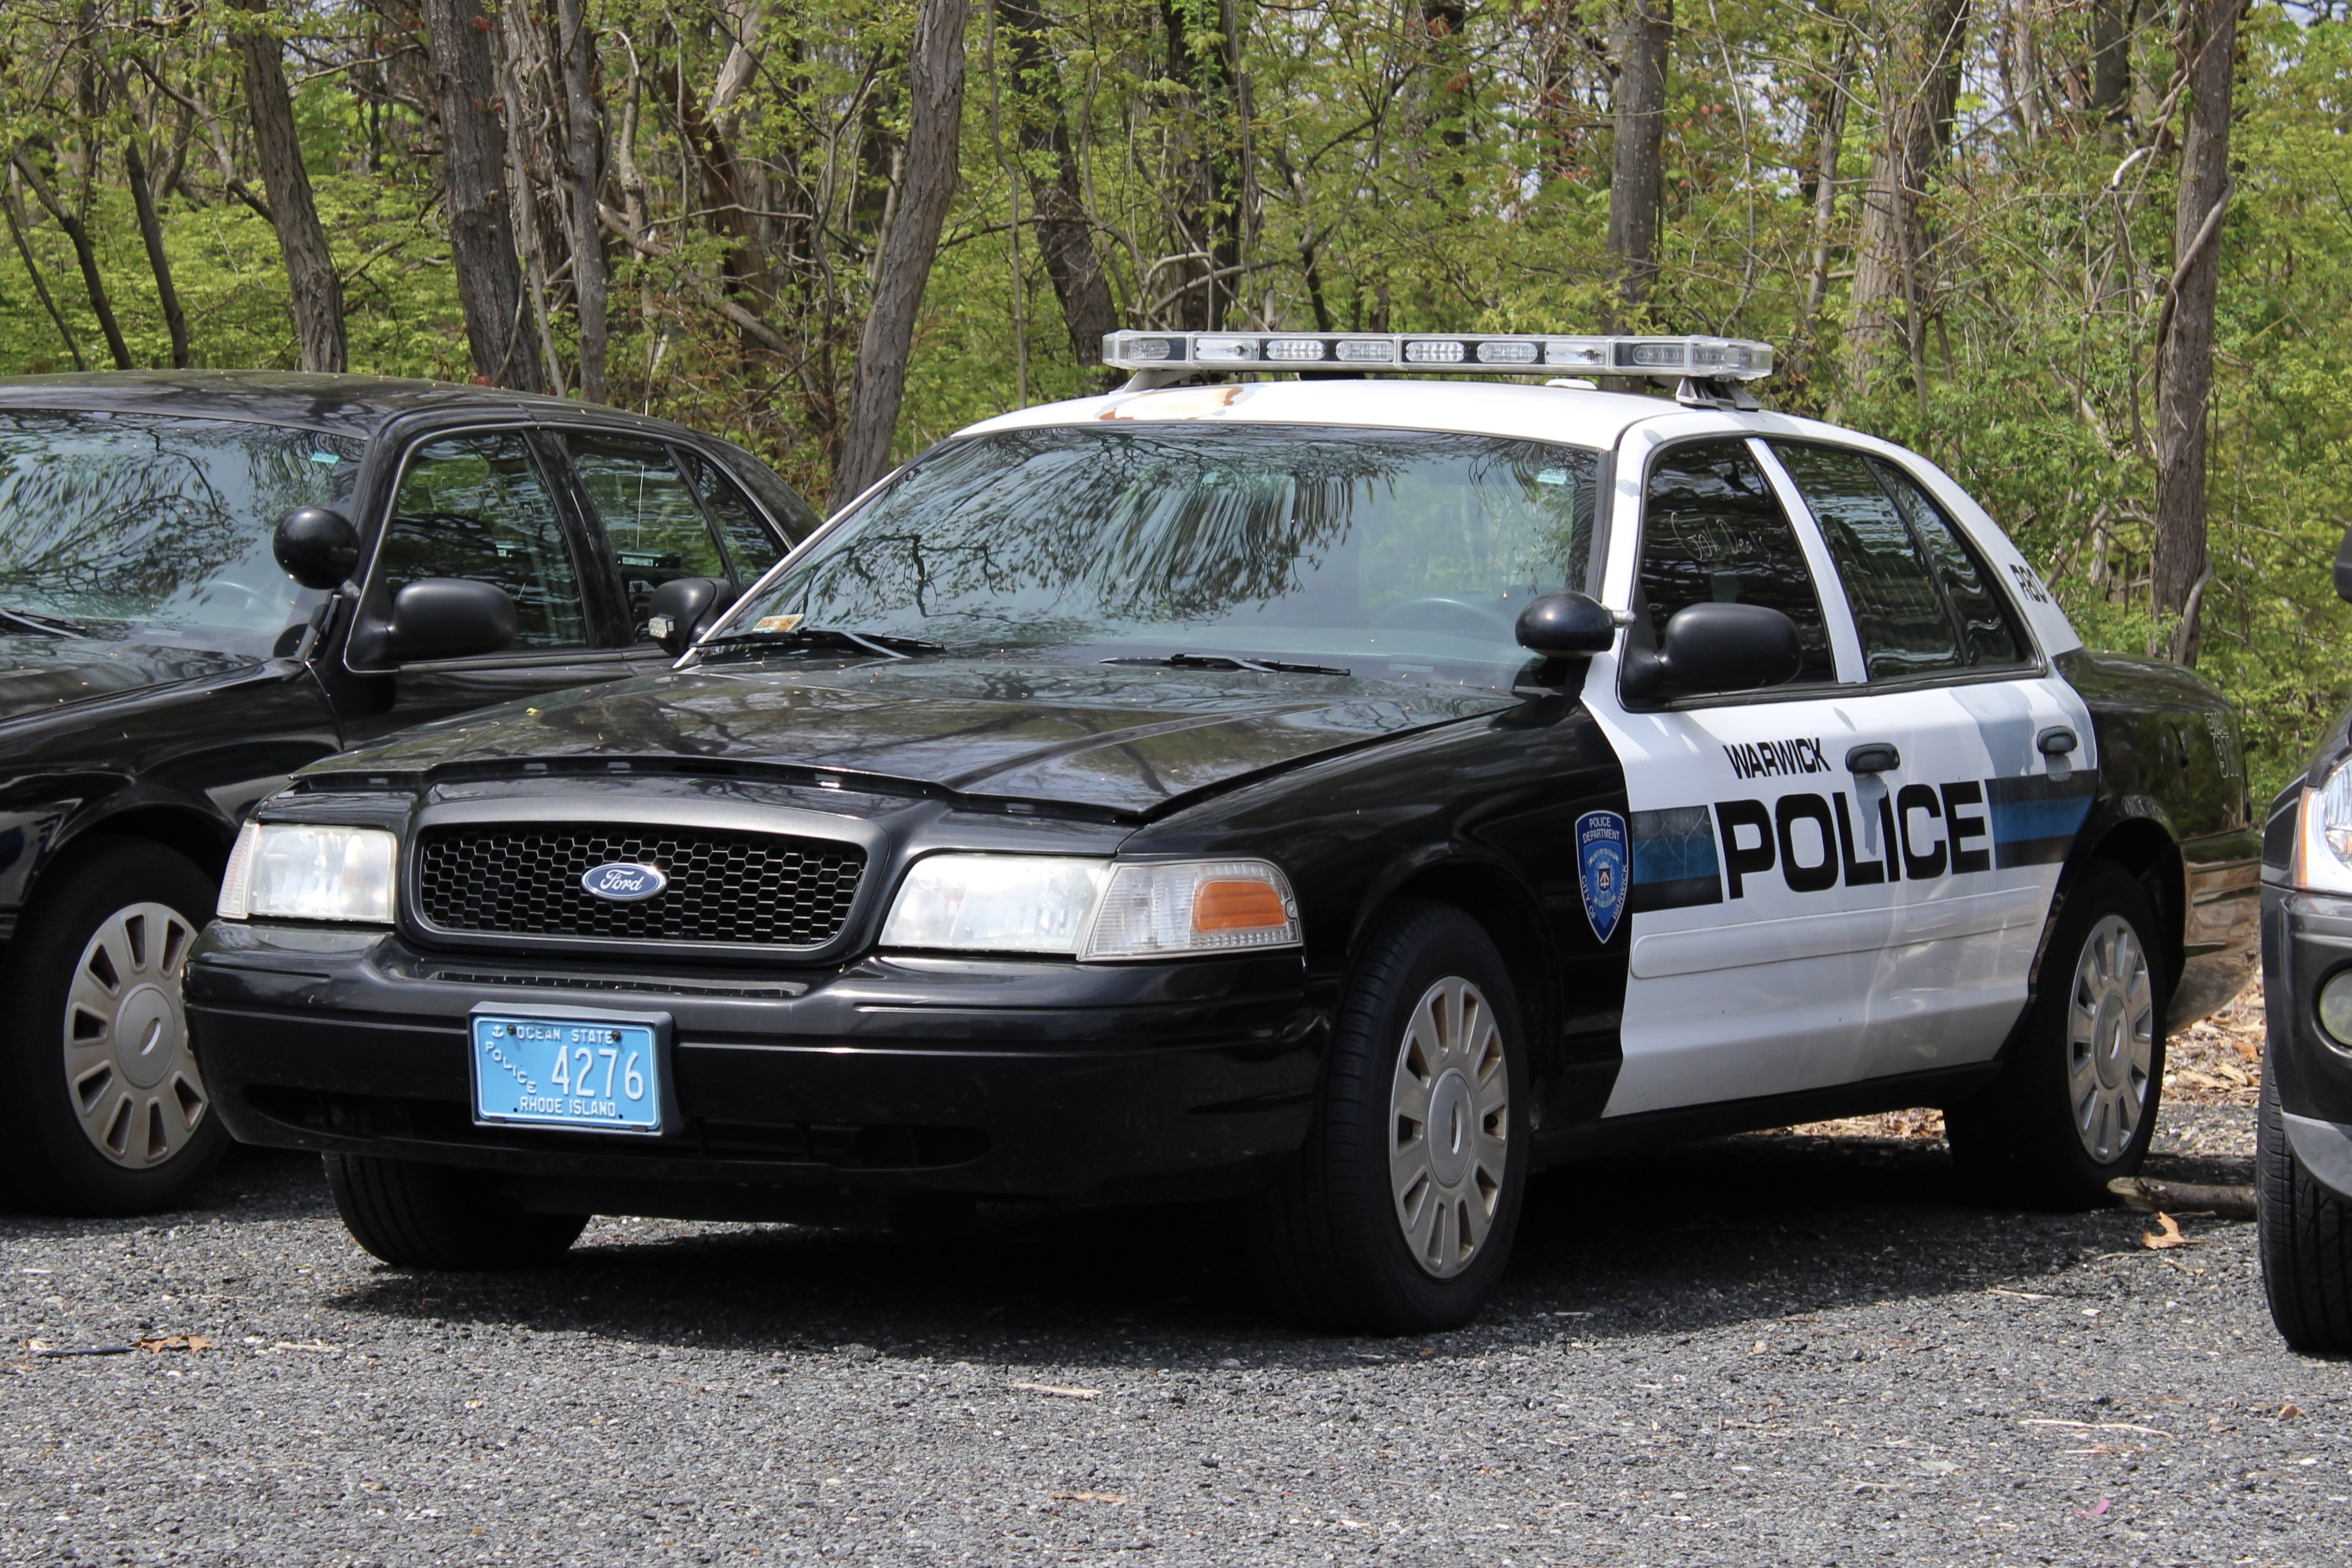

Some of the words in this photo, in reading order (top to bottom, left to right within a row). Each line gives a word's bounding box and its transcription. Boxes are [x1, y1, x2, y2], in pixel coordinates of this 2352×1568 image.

[2008, 563, 2049, 604] R80
[1722, 737, 1831, 780] WARWICK
[2213, 735, 2239, 778] 911
[1583, 828, 1620, 844] DEPARTMENT
[1589, 817, 1611, 828] POLICE
[1714, 780, 1991, 900] POLICE
[600, 869, 645, 892] Ford
[1581, 875, 1591, 902] CITY
[1588, 907, 1597, 921] OF
[1612, 864, 1627, 921] WARWICK
[516, 1026, 561, 1042] OCEAN
[571, 1030, 614, 1045] STATE
[485, 1041, 537, 1094] POLICE
[551, 1045, 645, 1100] 4276
[520, 1096, 563, 1115] RHODE
[569, 1099, 616, 1117] ISLAND
